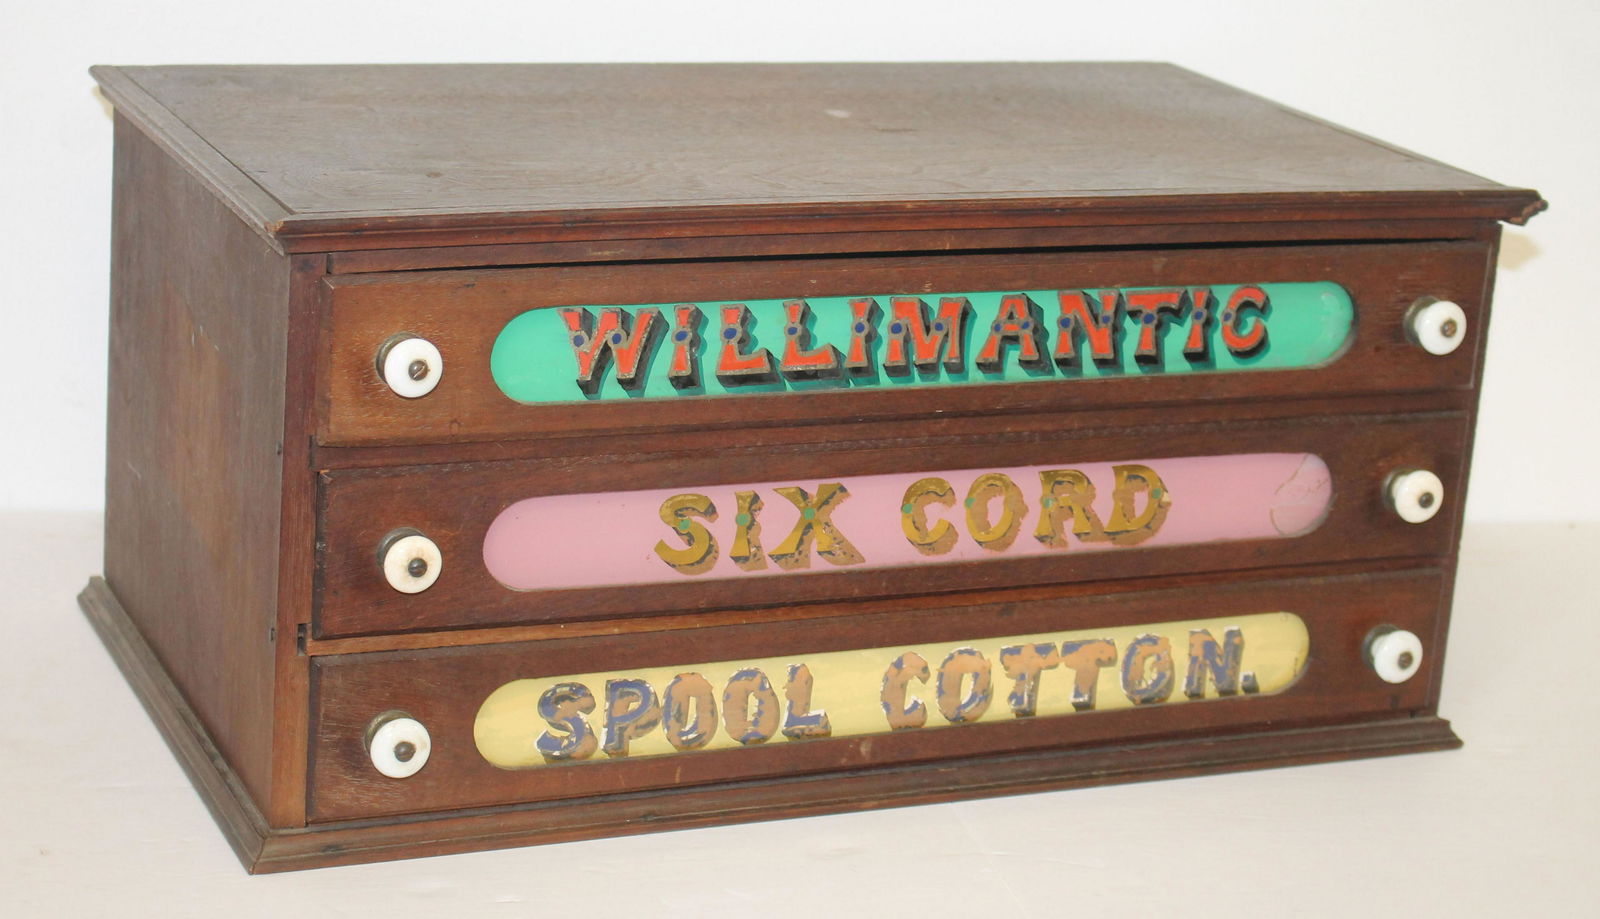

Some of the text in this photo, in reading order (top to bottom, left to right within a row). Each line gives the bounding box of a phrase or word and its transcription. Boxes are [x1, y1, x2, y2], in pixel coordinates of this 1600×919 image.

[557, 284, 1270, 399] WILLIMANTIC
[653, 464, 1172, 576] SIX CORD
[534, 625, 1260, 764] SPOOL COTTON.
